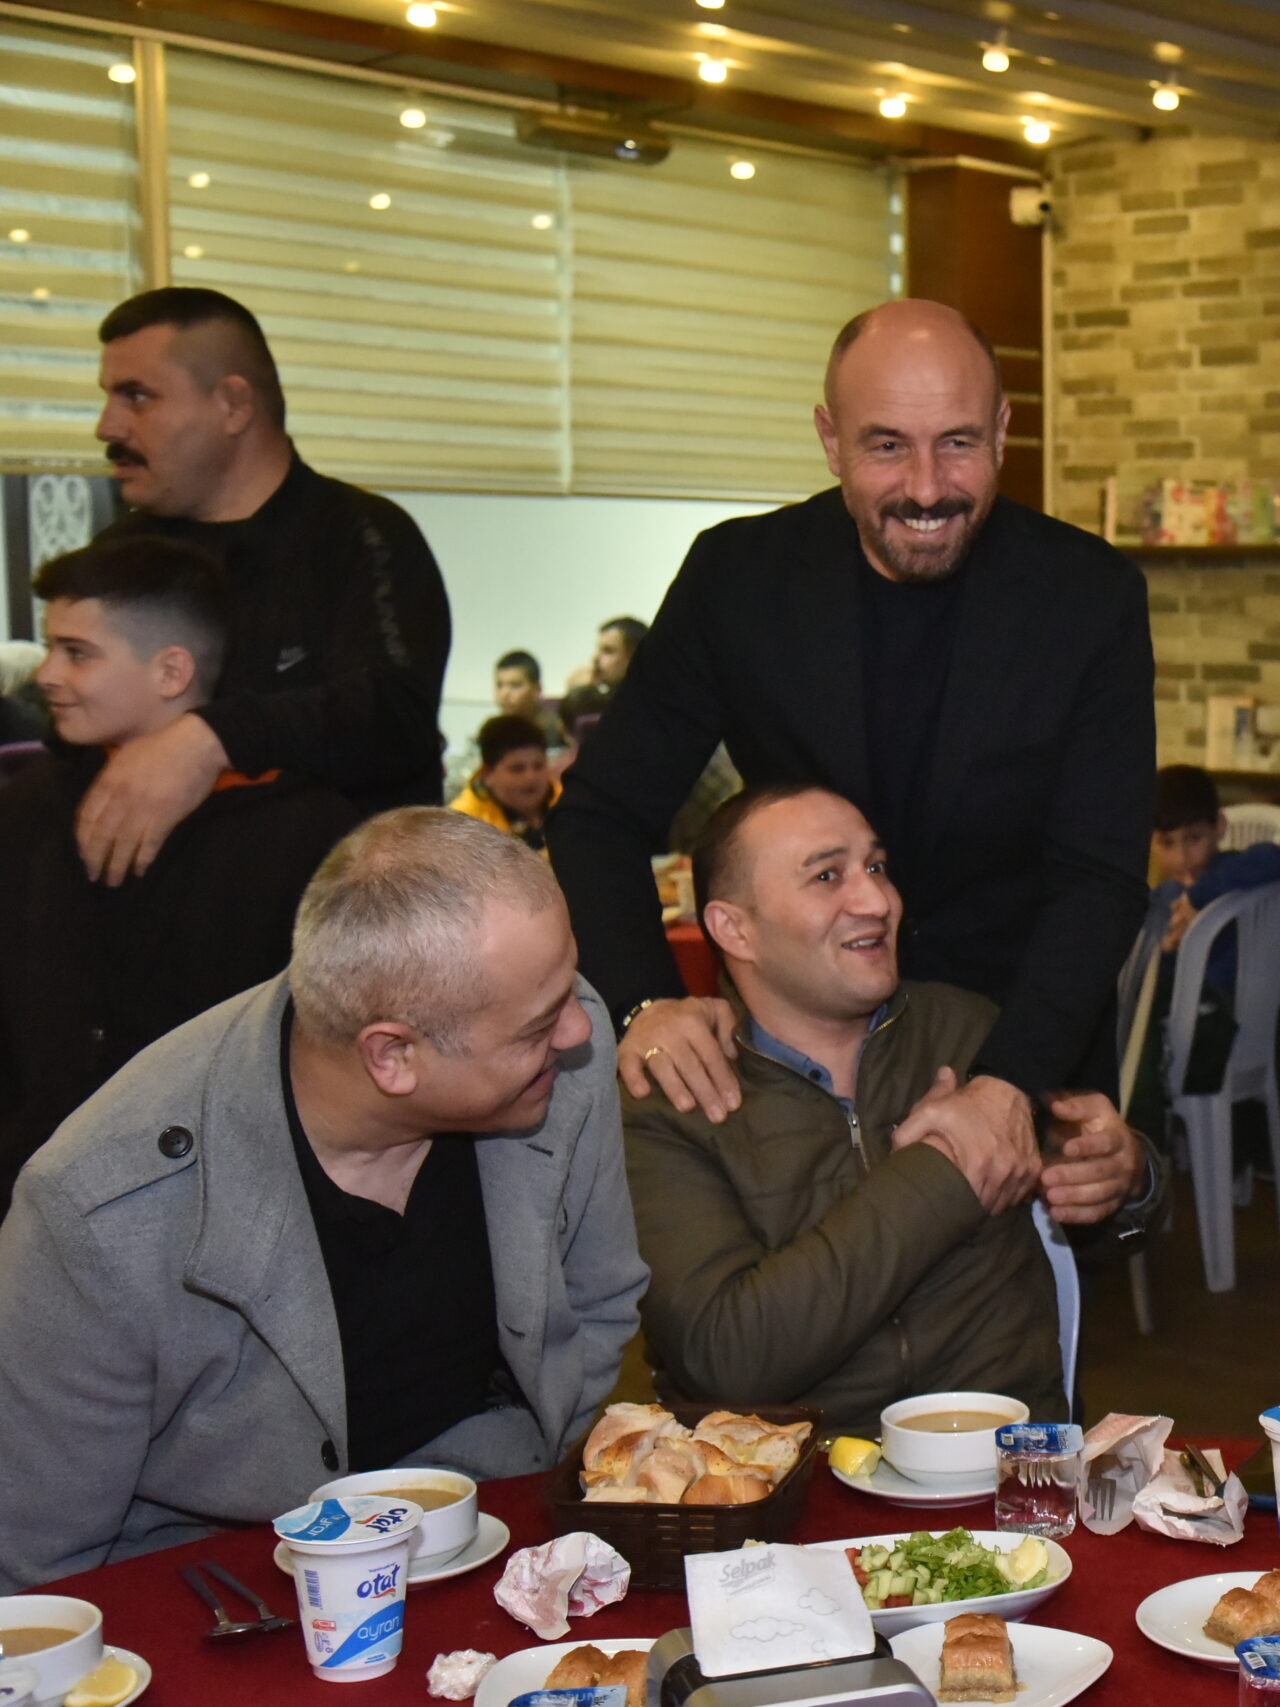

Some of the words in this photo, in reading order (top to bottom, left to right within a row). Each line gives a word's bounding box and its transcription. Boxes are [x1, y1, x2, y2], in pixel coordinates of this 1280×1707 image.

[357, 1564, 401, 1598] otat
[719, 1551, 776, 1582] Selpak
[357, 1616, 400, 1641] ayran
